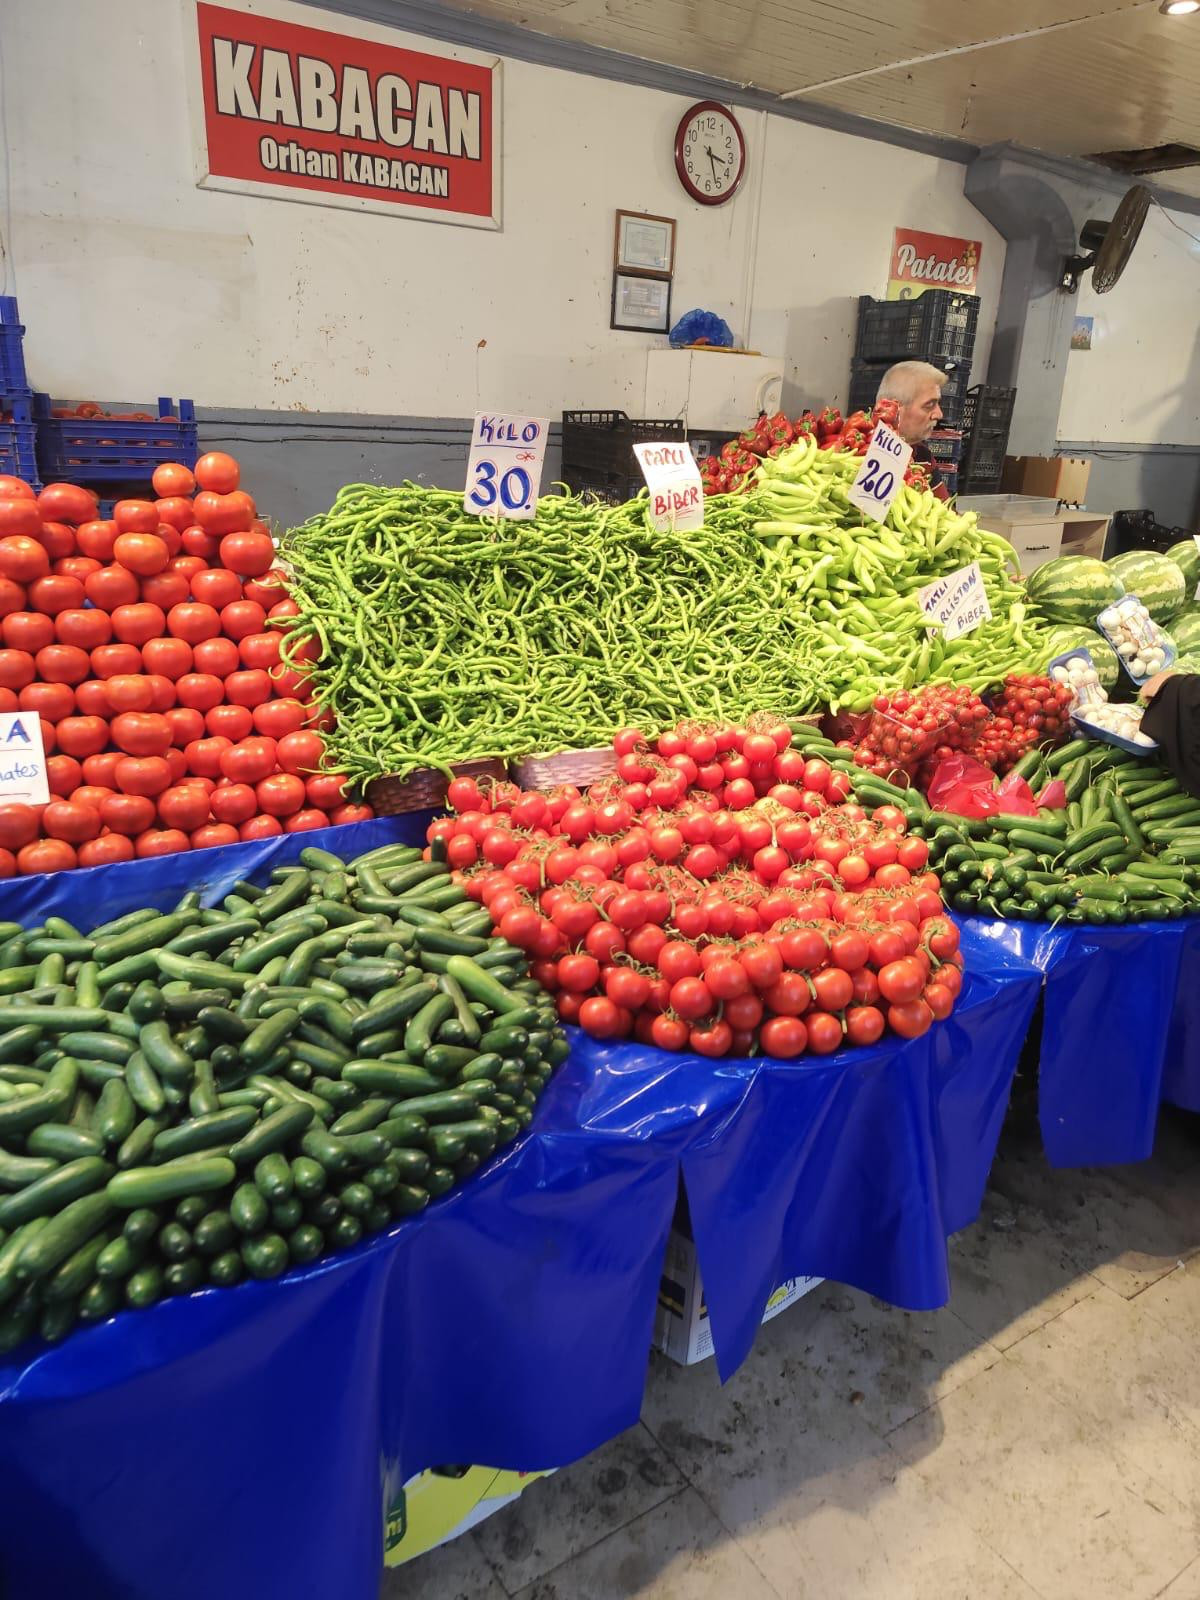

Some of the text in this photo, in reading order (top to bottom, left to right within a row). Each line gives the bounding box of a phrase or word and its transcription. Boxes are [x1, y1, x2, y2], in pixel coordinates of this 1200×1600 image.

[211, 34, 482, 161] KABACAN
[697, 119, 705, 132] 11
[707, 117, 716, 130] 12
[688, 129, 698, 142] 10
[725, 136, 732, 149] 2
[684, 144, 691, 157] 9
[727, 152, 734, 165] 3
[259, 135, 449, 199] Orhan KABACAN
[687, 161, 694, 174] 8
[723, 167, 730, 180] 4
[695, 173, 701, 185] 7
[705, 179, 711, 192] 6
[715, 177, 722, 189] 5
[897, 243, 976, 286] Patates
[857, 459, 894, 500] 20
[0, 762, 38, 781] ates
